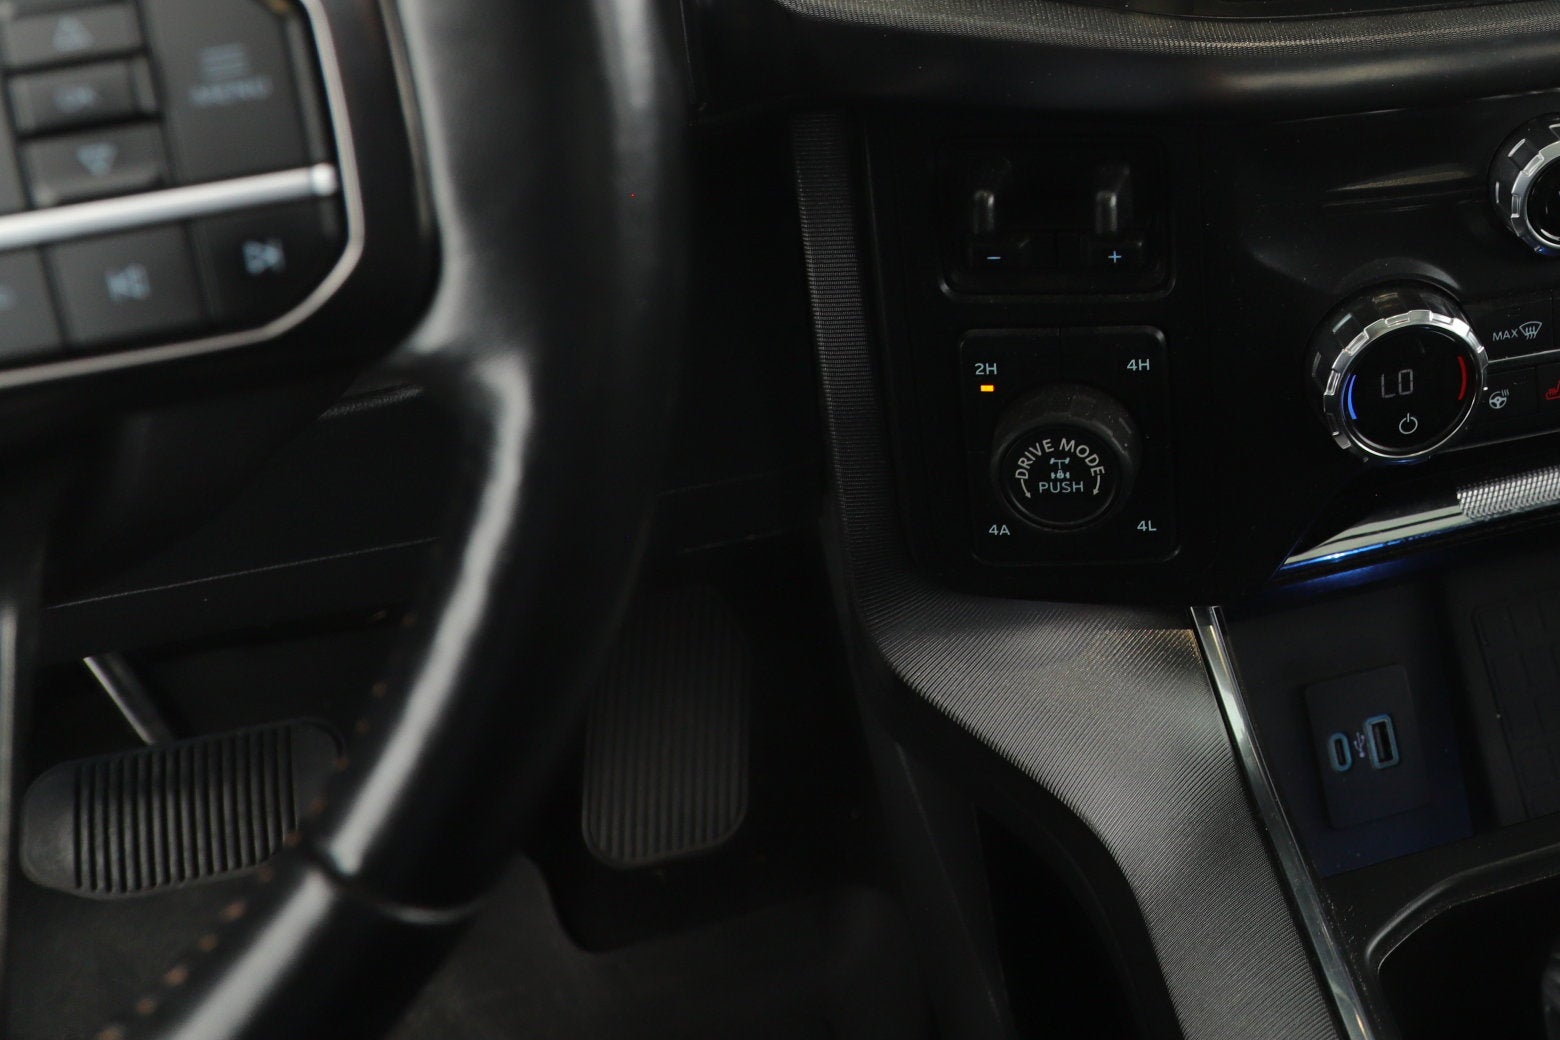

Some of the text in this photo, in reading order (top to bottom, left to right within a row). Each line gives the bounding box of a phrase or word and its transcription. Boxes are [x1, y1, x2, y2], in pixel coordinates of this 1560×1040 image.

[1492, 329, 1519, 342] MAX
[975, 362, 998, 376] 2H
[1126, 358, 1150, 372] 4H
[1015, 438, 1105, 481] DRIVE MODE
[1038, 481, 1084, 494] PUSH
[988, 524, 1011, 537] 4A
[1136, 520, 1157, 532] 4L
